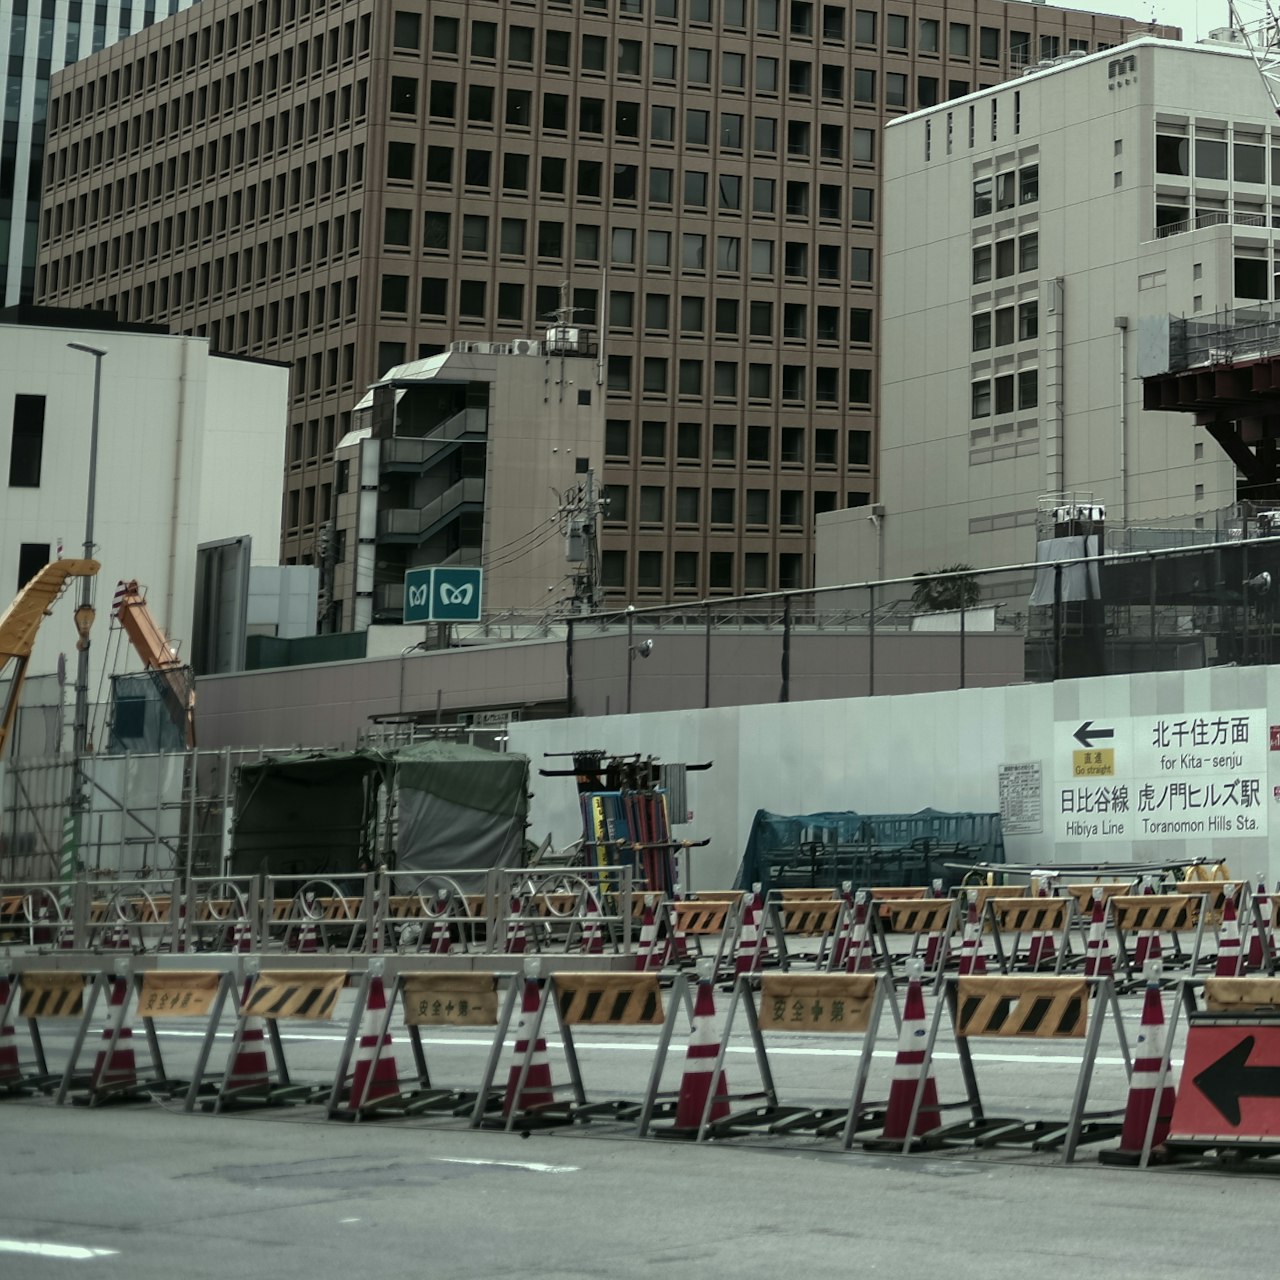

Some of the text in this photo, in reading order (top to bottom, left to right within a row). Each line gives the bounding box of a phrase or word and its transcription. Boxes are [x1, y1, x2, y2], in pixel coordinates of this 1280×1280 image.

[1152, 716, 1250, 748] 北千住方面
[1084, 752, 1103, 764] 直進
[1160, 751, 1243, 771] for Kita-senju
[1075, 765, 1112, 776] Go straight
[1061, 785, 1130, 814] 日比谷線
[1137, 778, 1261, 812] 虎ノ門ヒルズ駅
[1066, 819, 1125, 839] Hibiya Line
[1142, 814, 1259, 833] Toranomon Hills Sta.
